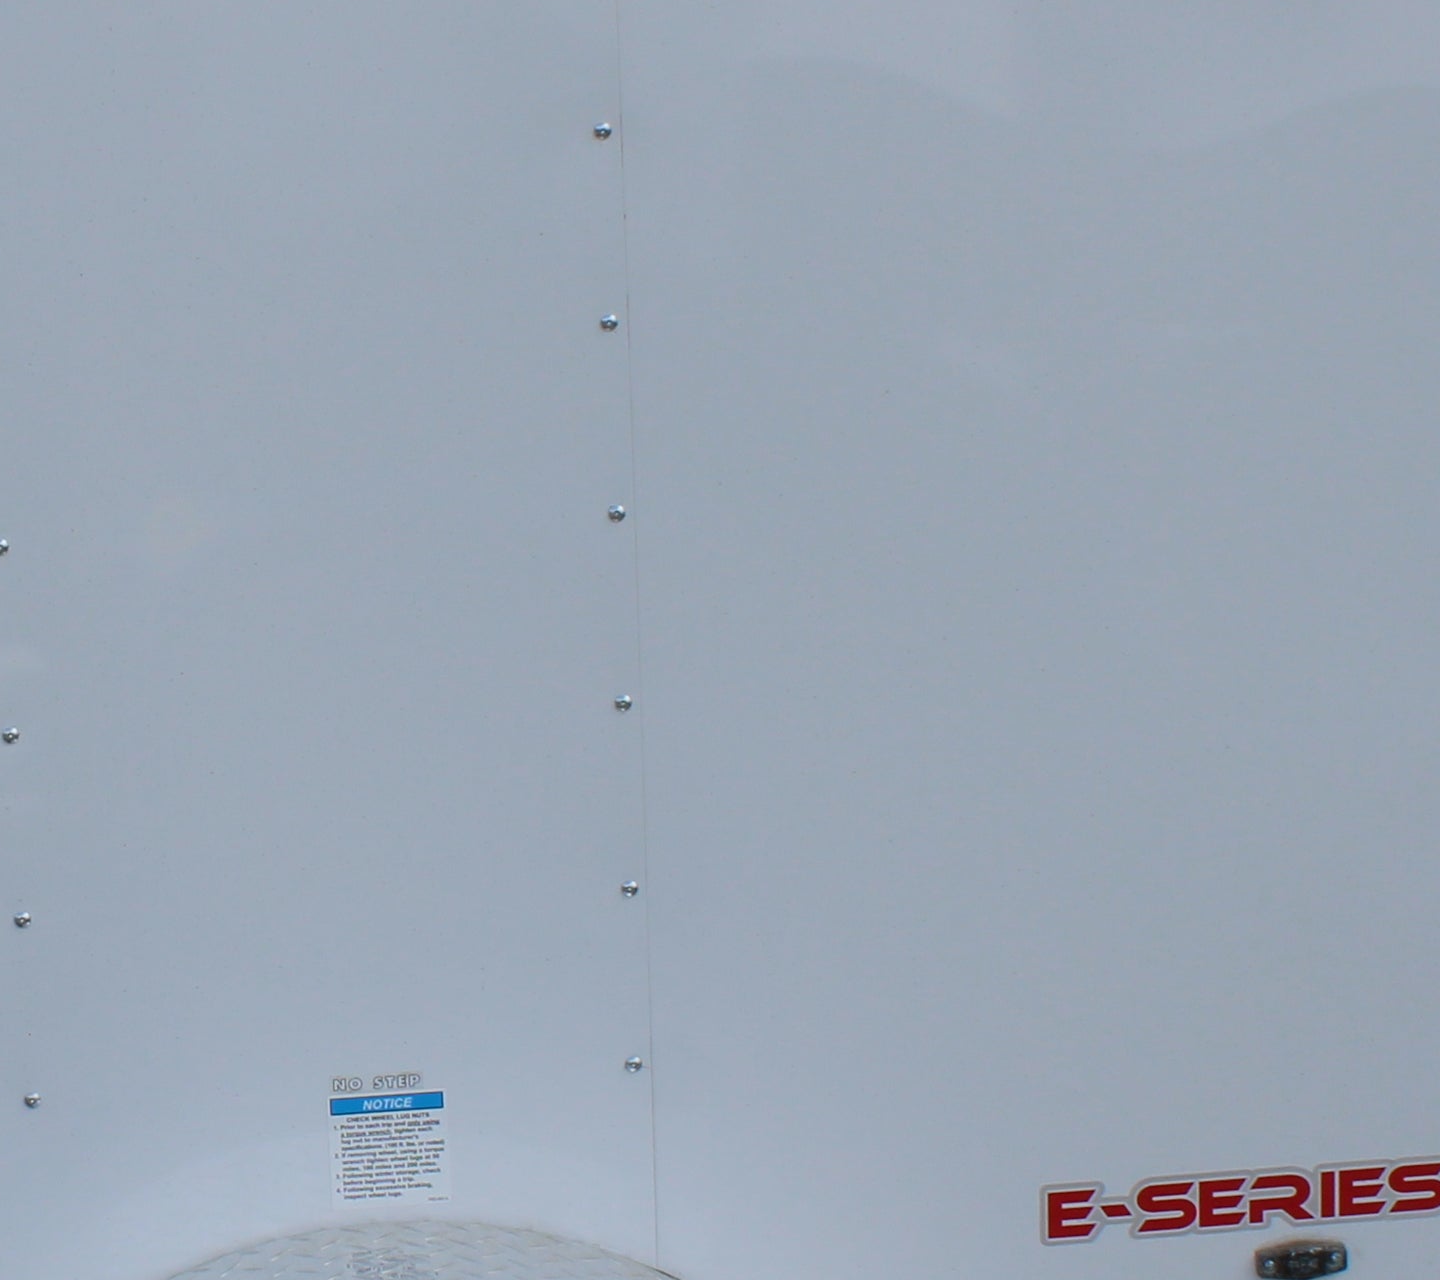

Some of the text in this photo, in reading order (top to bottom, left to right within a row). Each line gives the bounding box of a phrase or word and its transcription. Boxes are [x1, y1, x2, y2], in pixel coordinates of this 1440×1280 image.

[333, 1074, 421, 1092] NO STEP
[363, 1097, 413, 1111] NOTICE
